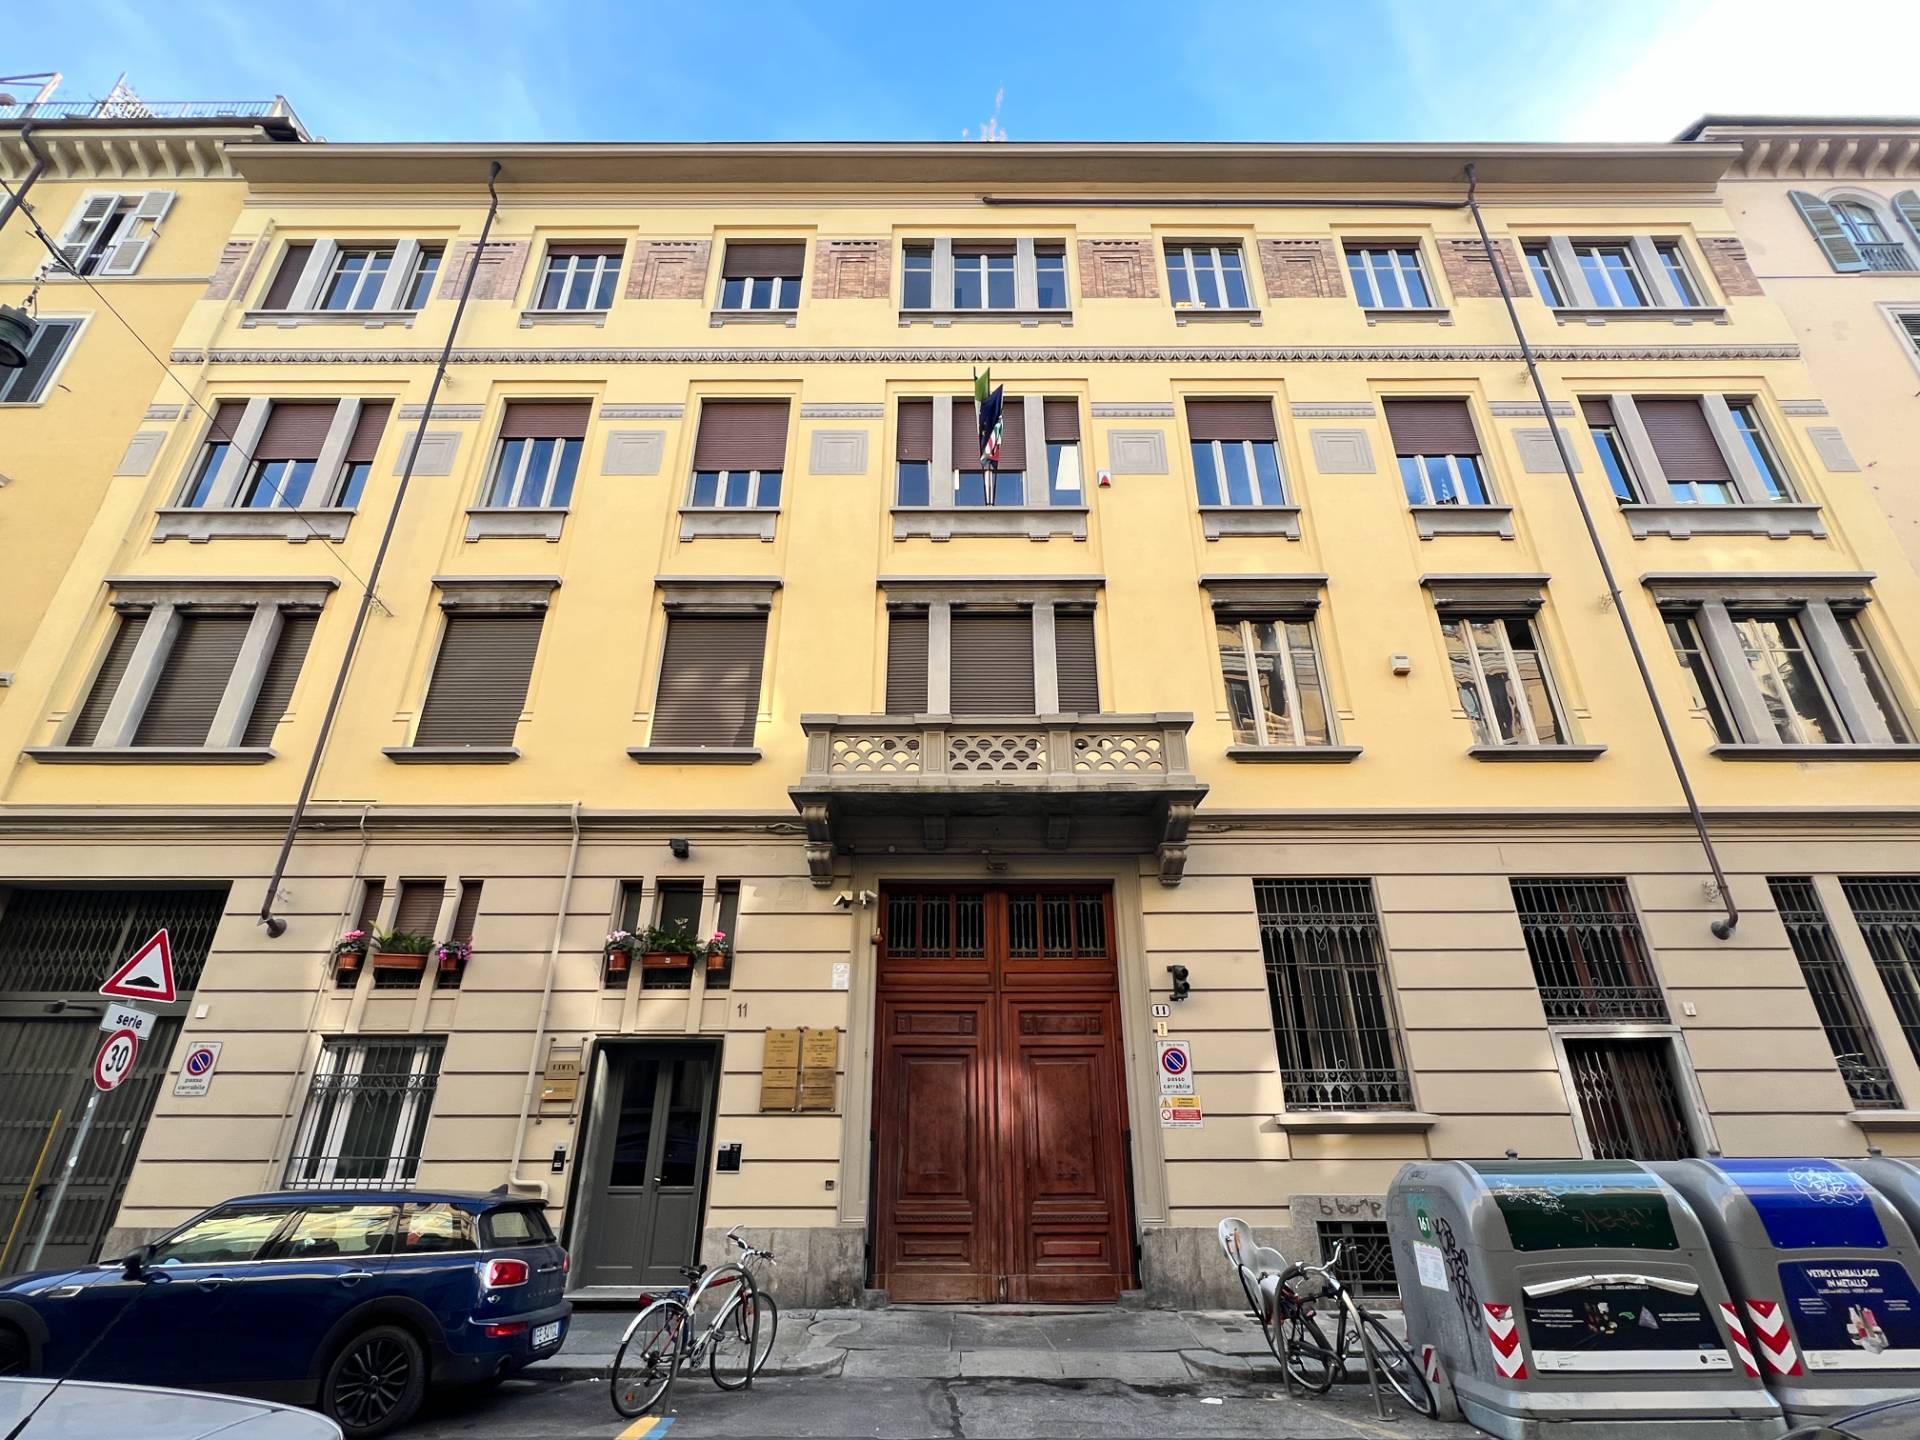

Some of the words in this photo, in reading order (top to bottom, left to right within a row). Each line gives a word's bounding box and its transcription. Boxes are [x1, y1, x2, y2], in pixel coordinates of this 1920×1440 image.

[737, 1003, 748, 1018] 11
[1156, 1006, 1166, 1015] 11
[116, 1014, 142, 1029] serie
[105, 1044, 129, 1072] 30
[1418, 1216, 1430, 1231] 161
[1806, 1269, 1831, 1278] VETRO
[1831, 1269, 1837, 1277] E
[1836, 1269, 1880, 1277] IMBALLAGGI
[1826, 1279, 1836, 1287] IN
[1836, 1279, 1869, 1287] METALLO
